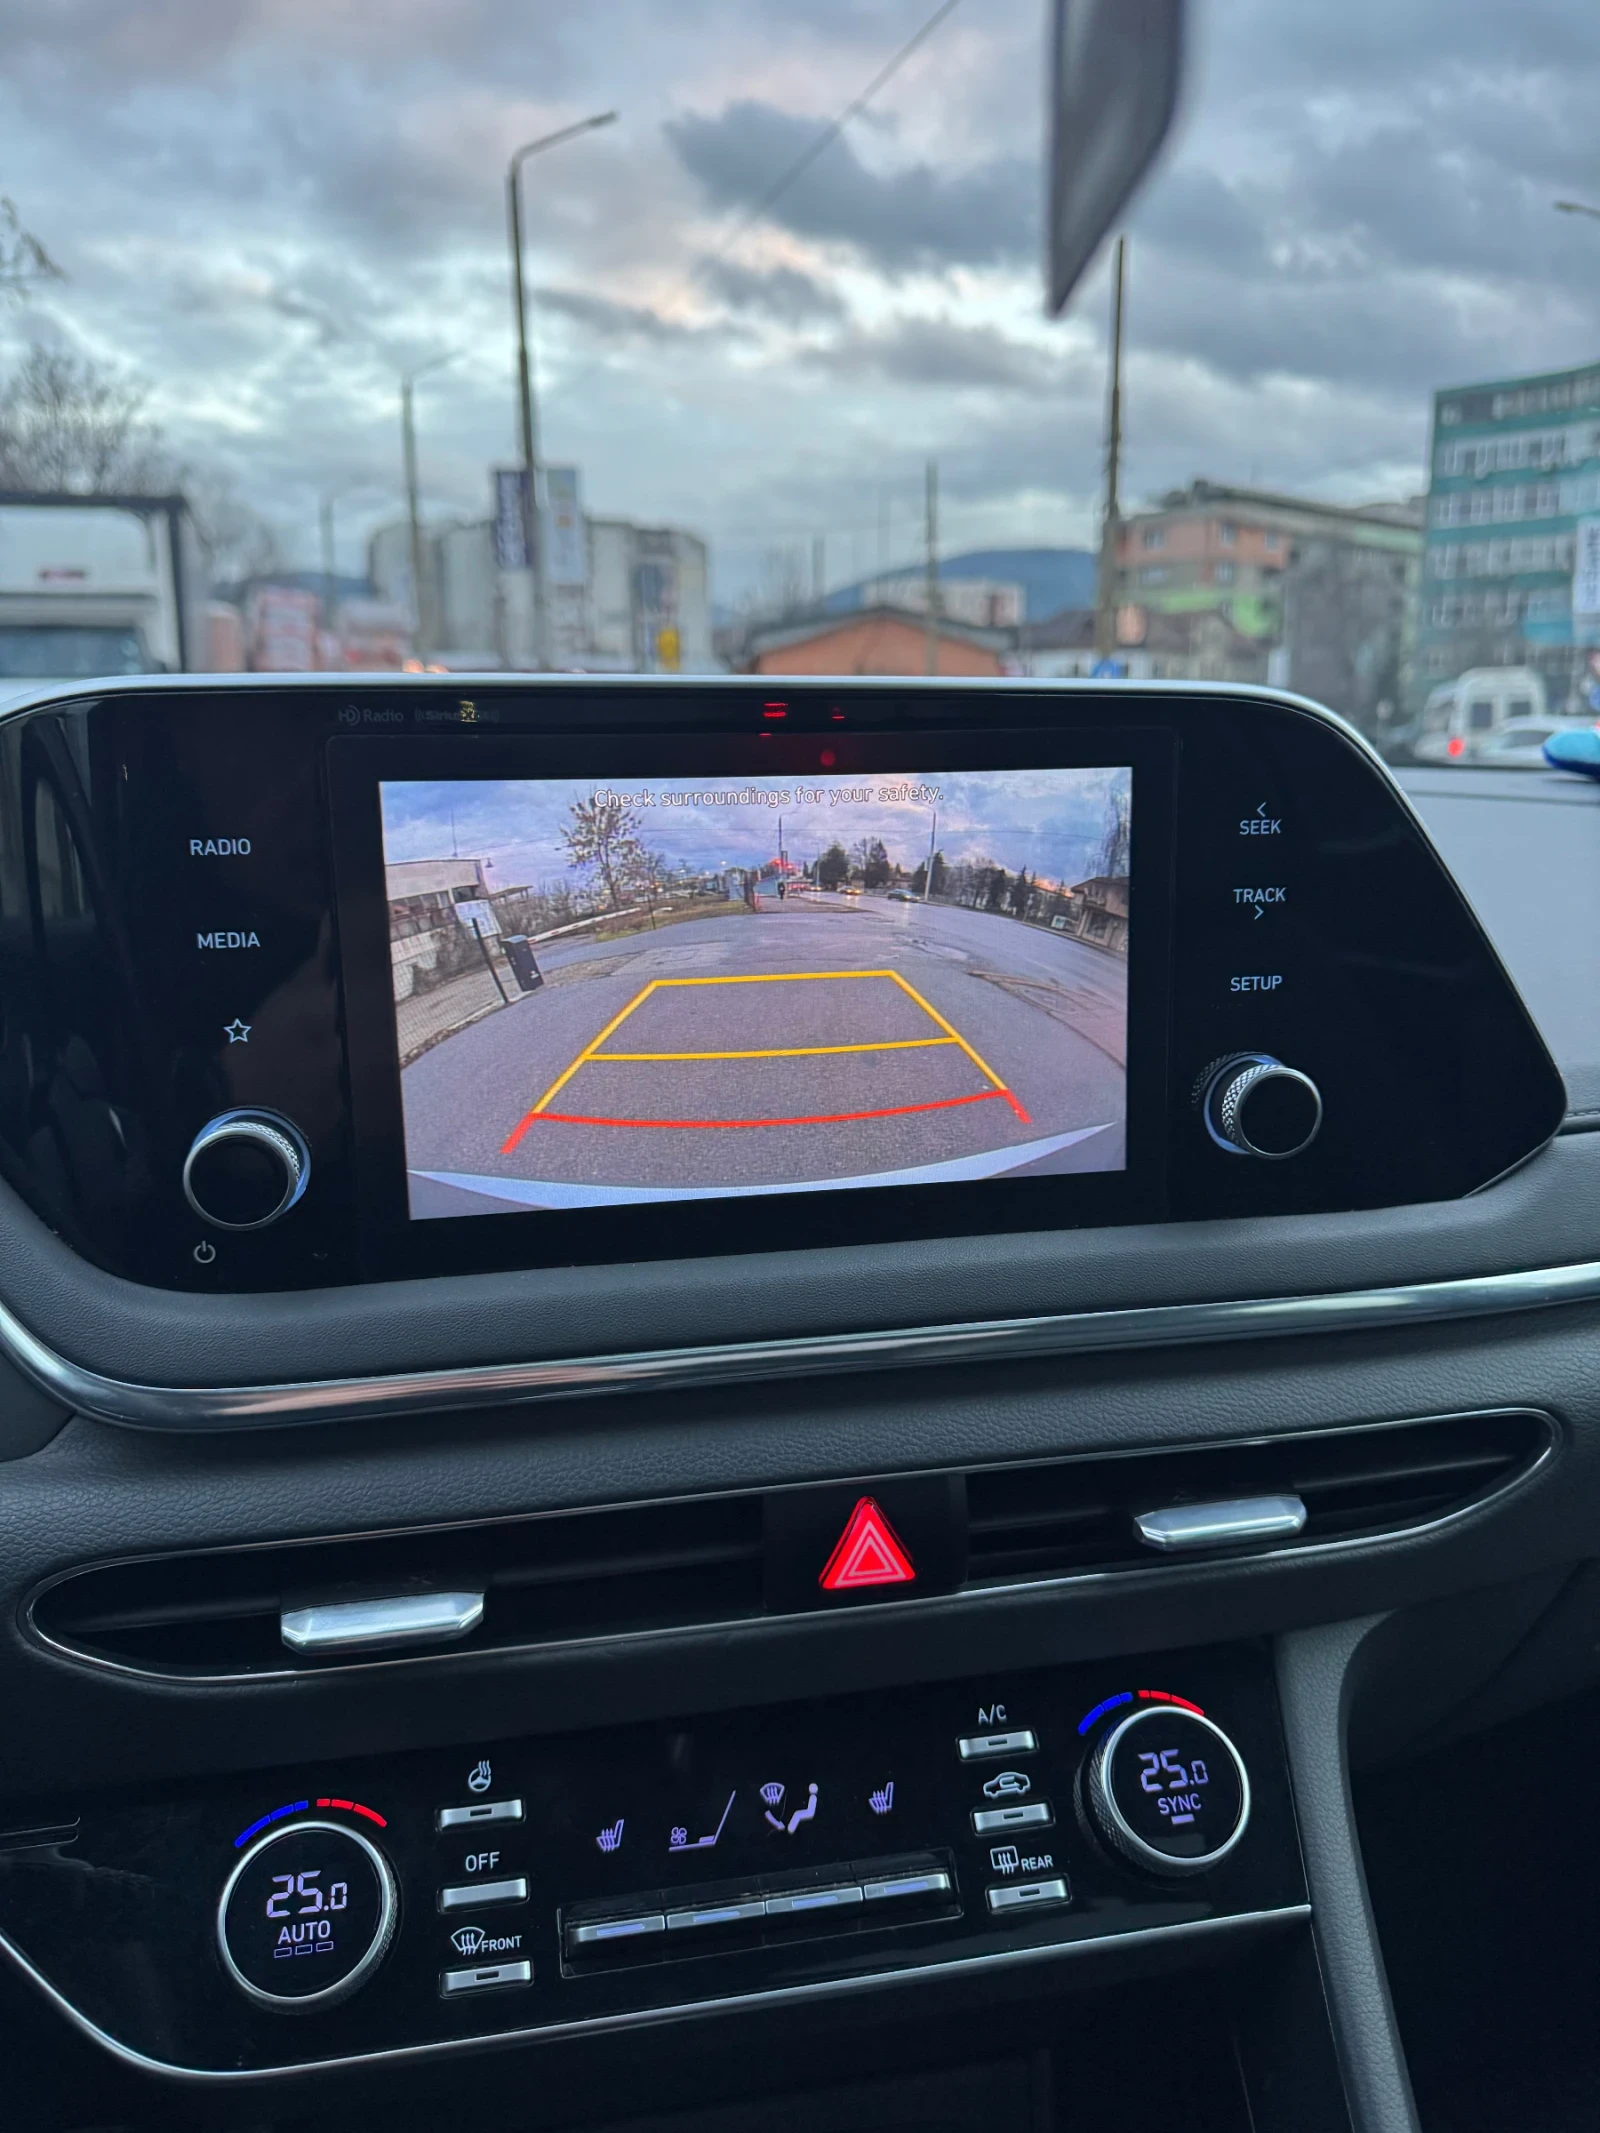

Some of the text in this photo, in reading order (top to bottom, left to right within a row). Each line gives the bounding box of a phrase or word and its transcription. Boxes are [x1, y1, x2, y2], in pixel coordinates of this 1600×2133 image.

[363, 708, 404, 723] Radio
[594, 783, 944, 808] Check surroundings for your safety.
[1239, 819, 1282, 835] SEEK
[189, 838, 252, 856] RADIO
[1233, 887, 1287, 903] TRACK
[196, 931, 261, 949] MEDIA
[1230, 975, 1283, 992] SETUP
[978, 1704, 1007, 1725] A/C
[1137, 1748, 1209, 1793] 25.0
[1157, 1793, 1202, 1815] SYNC
[465, 1851, 500, 1872] OFF
[1021, 1854, 1054, 1872] REAR
[266, 1870, 348, 1918] 25.0
[277, 1920, 331, 1945] AUTO
[481, 1935, 522, 1953] FRONT
